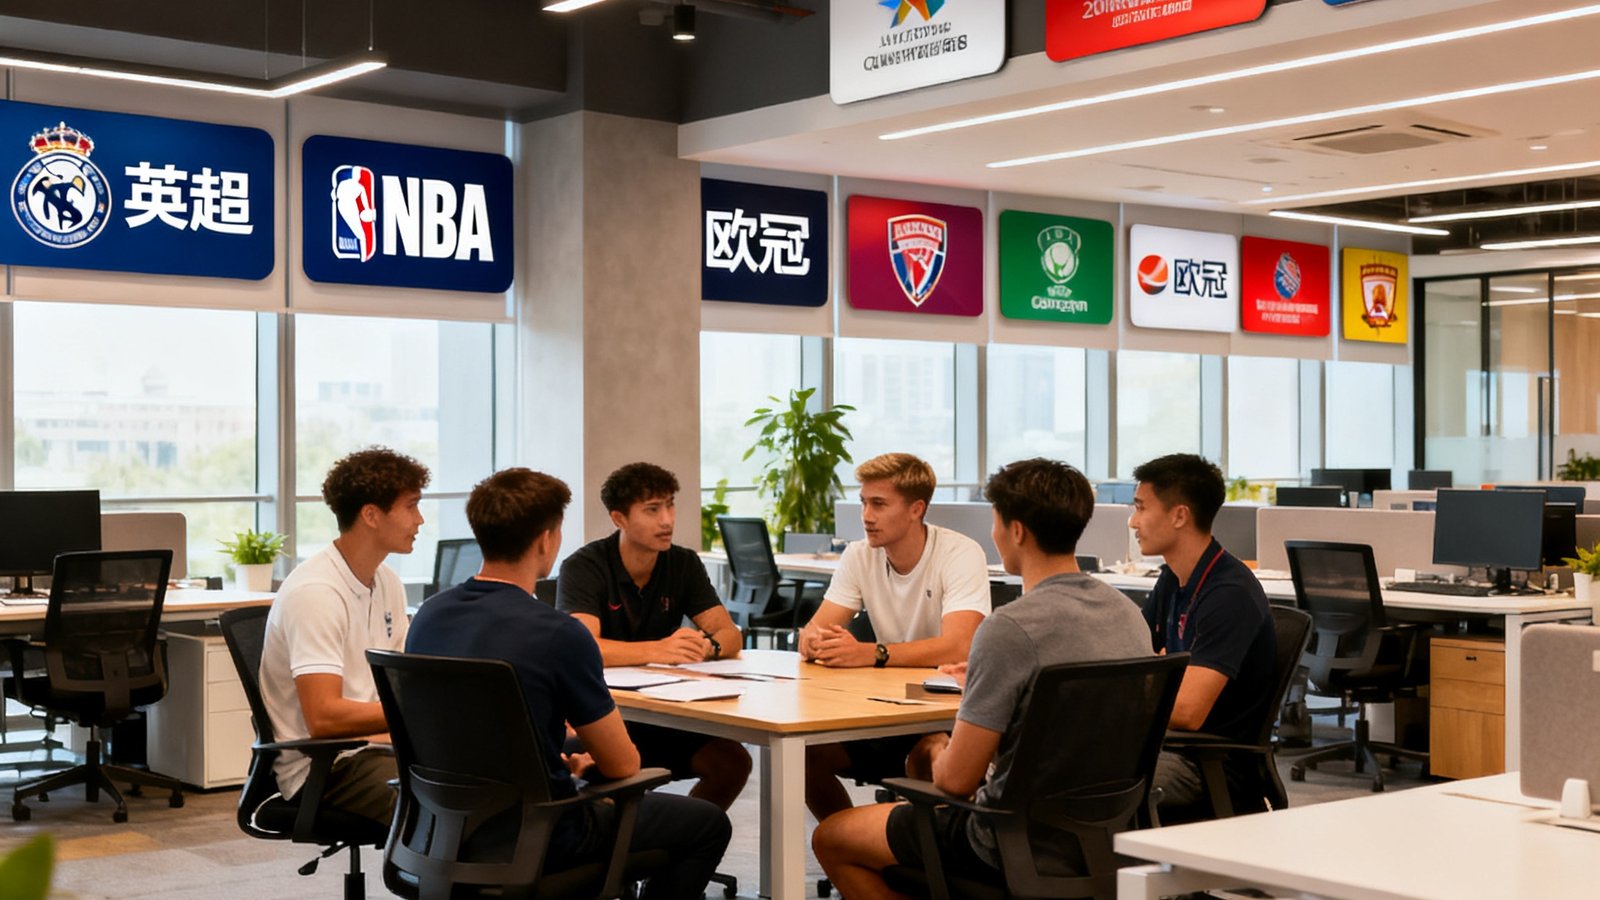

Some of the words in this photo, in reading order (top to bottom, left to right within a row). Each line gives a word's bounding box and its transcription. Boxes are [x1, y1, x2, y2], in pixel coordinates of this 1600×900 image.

[123, 161, 254, 235] 英超
[381, 175, 494, 262] NBA
[705, 208, 811, 276] 欧冠
[1174, 258, 1228, 299] 欧冠
